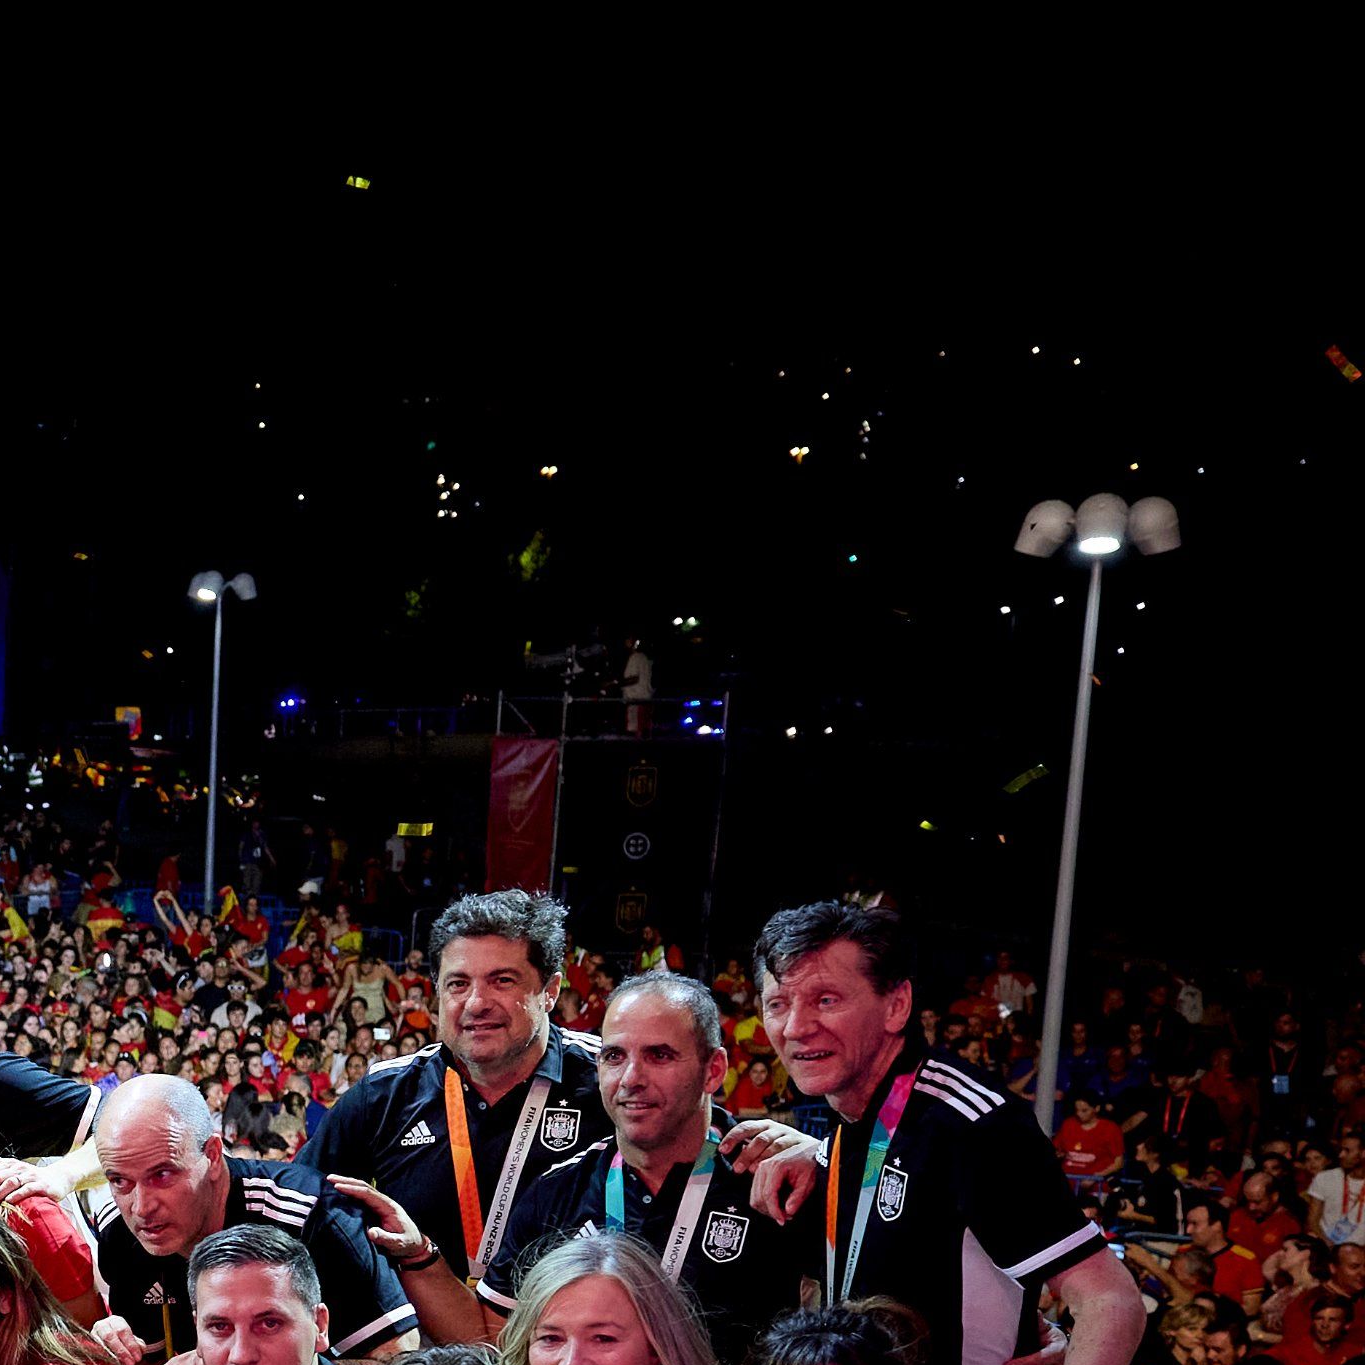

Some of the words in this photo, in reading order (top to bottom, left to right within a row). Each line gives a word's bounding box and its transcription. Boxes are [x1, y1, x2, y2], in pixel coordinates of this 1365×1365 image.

[524, 1107, 536, 1124] FIFA
[401, 1135, 435, 1146] adidas
[512, 1123, 530, 1162] WOMEN'S
[503, 1163, 518, 1194] WORLD
[498, 1194, 510, 1211] CUP
[674, 1227, 687, 1248] FIFA
